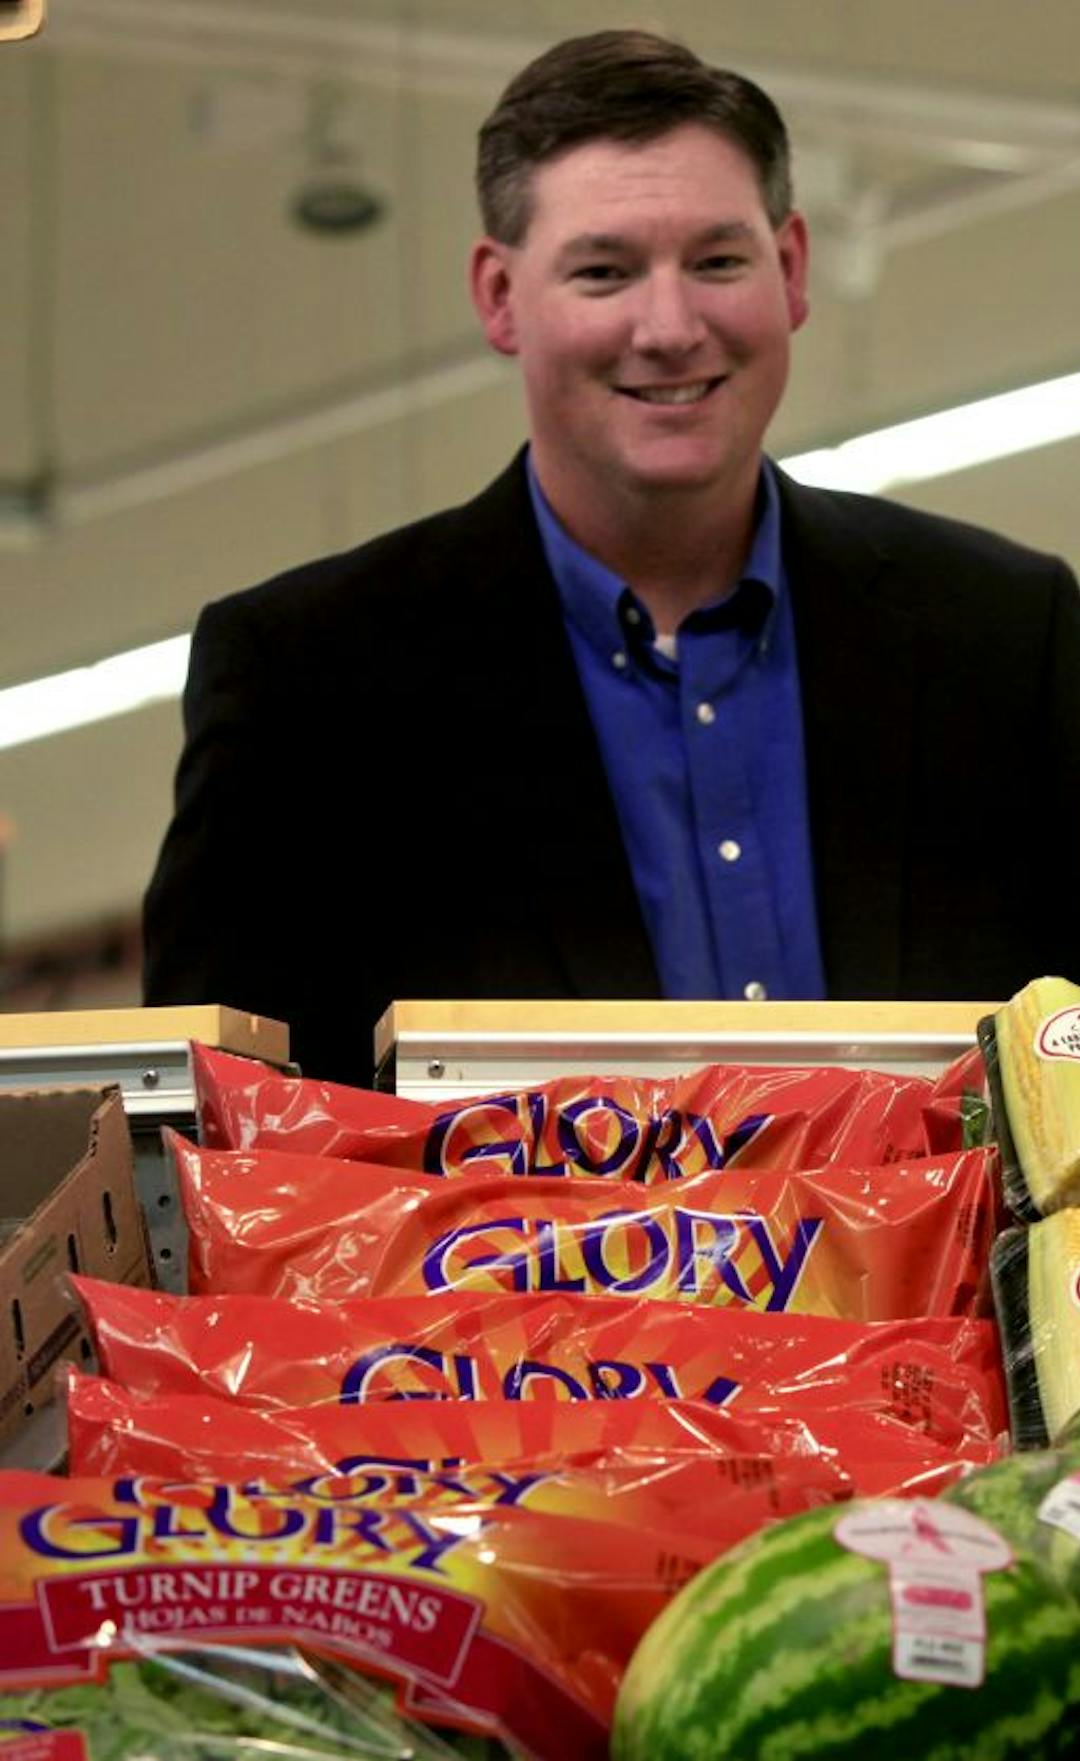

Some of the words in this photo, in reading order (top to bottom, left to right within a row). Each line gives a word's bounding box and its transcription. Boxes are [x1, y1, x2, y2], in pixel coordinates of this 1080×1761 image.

[423, 1092, 775, 1183] GLORY
[422, 1205, 824, 1313] GLORY
[18, 1500, 492, 1573] GLORY
[80, 1571, 260, 1611] TURNIP
[268, 1574, 442, 1632] GREENS
[236, 1606, 270, 1623] DE
